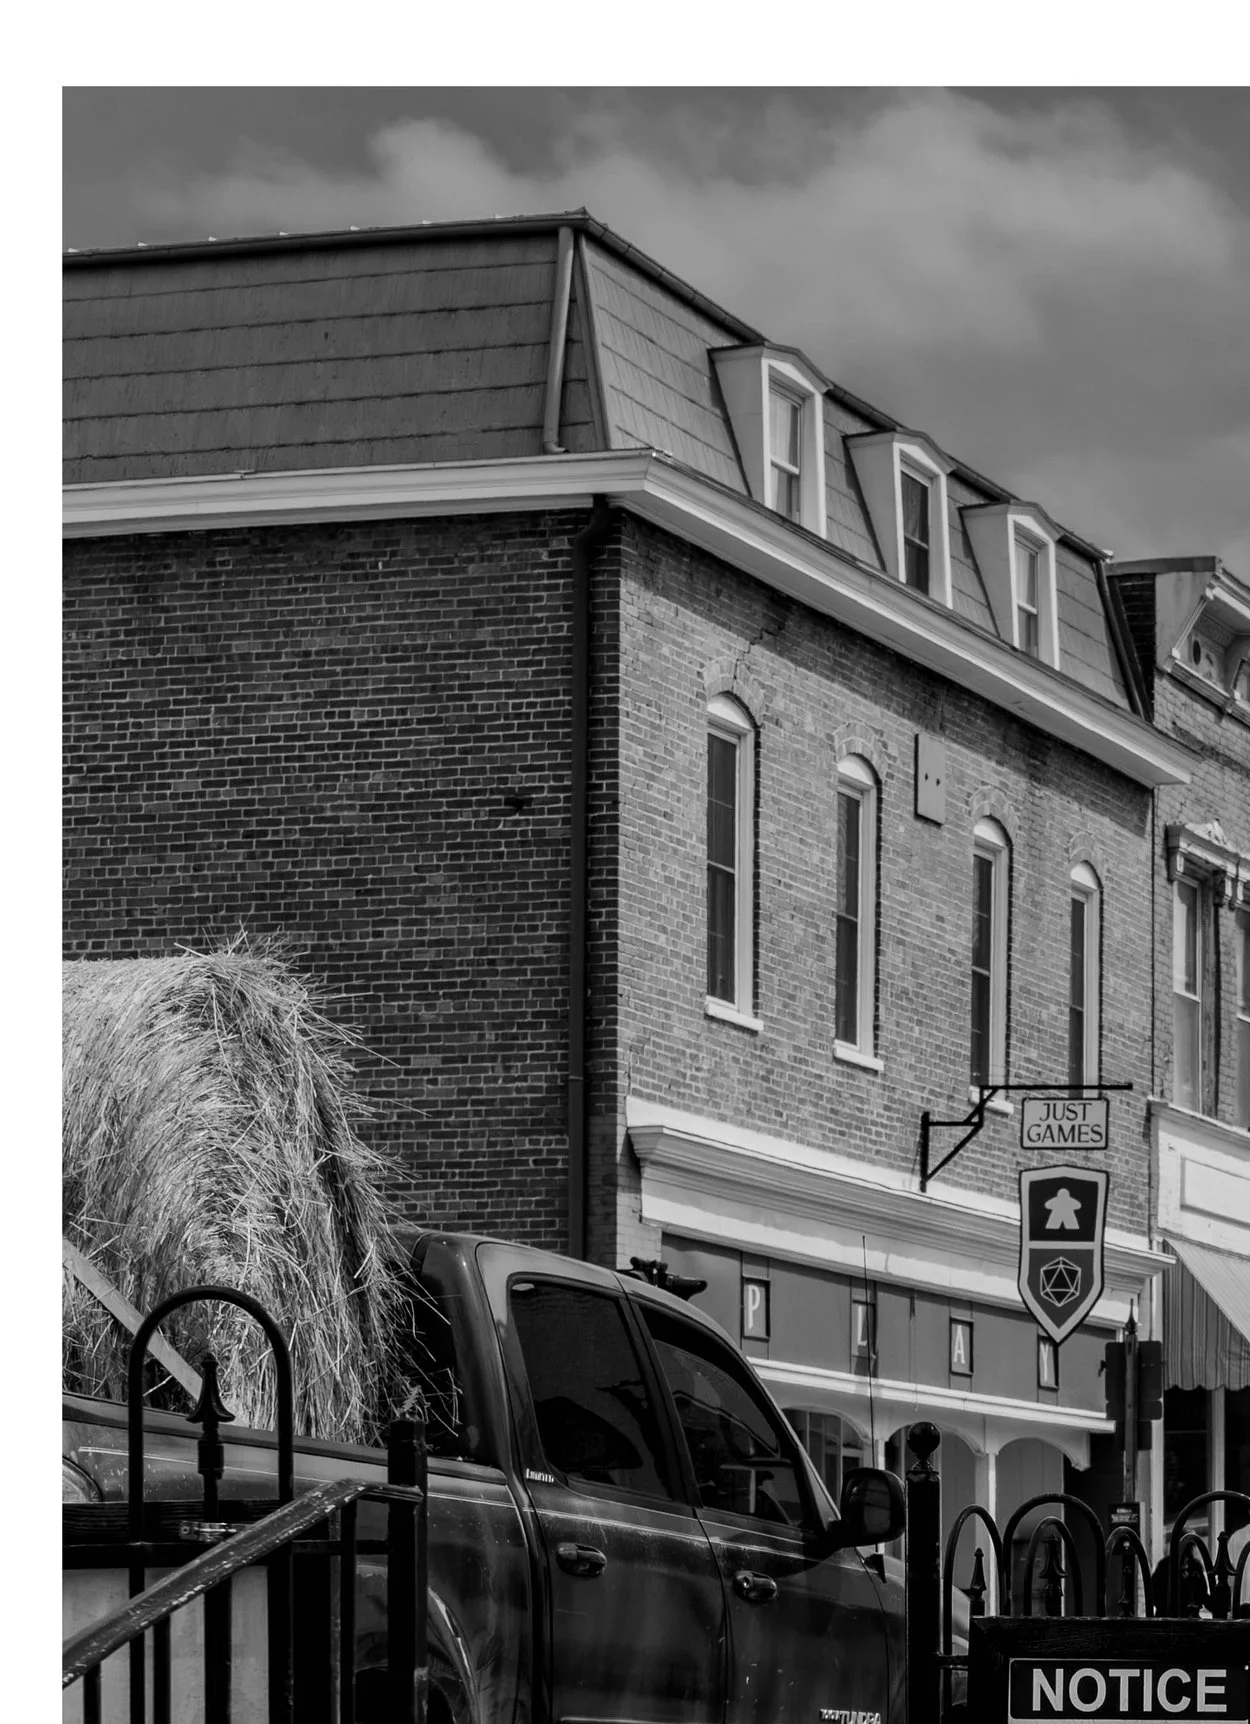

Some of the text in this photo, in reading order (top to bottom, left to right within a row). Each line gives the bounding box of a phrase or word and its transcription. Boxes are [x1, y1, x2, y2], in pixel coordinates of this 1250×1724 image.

[1039, 1102, 1092, 1121] JUST
[1027, 1123, 1104, 1143] GAMES
[1032, 1667, 1227, 1713] NOTICE
